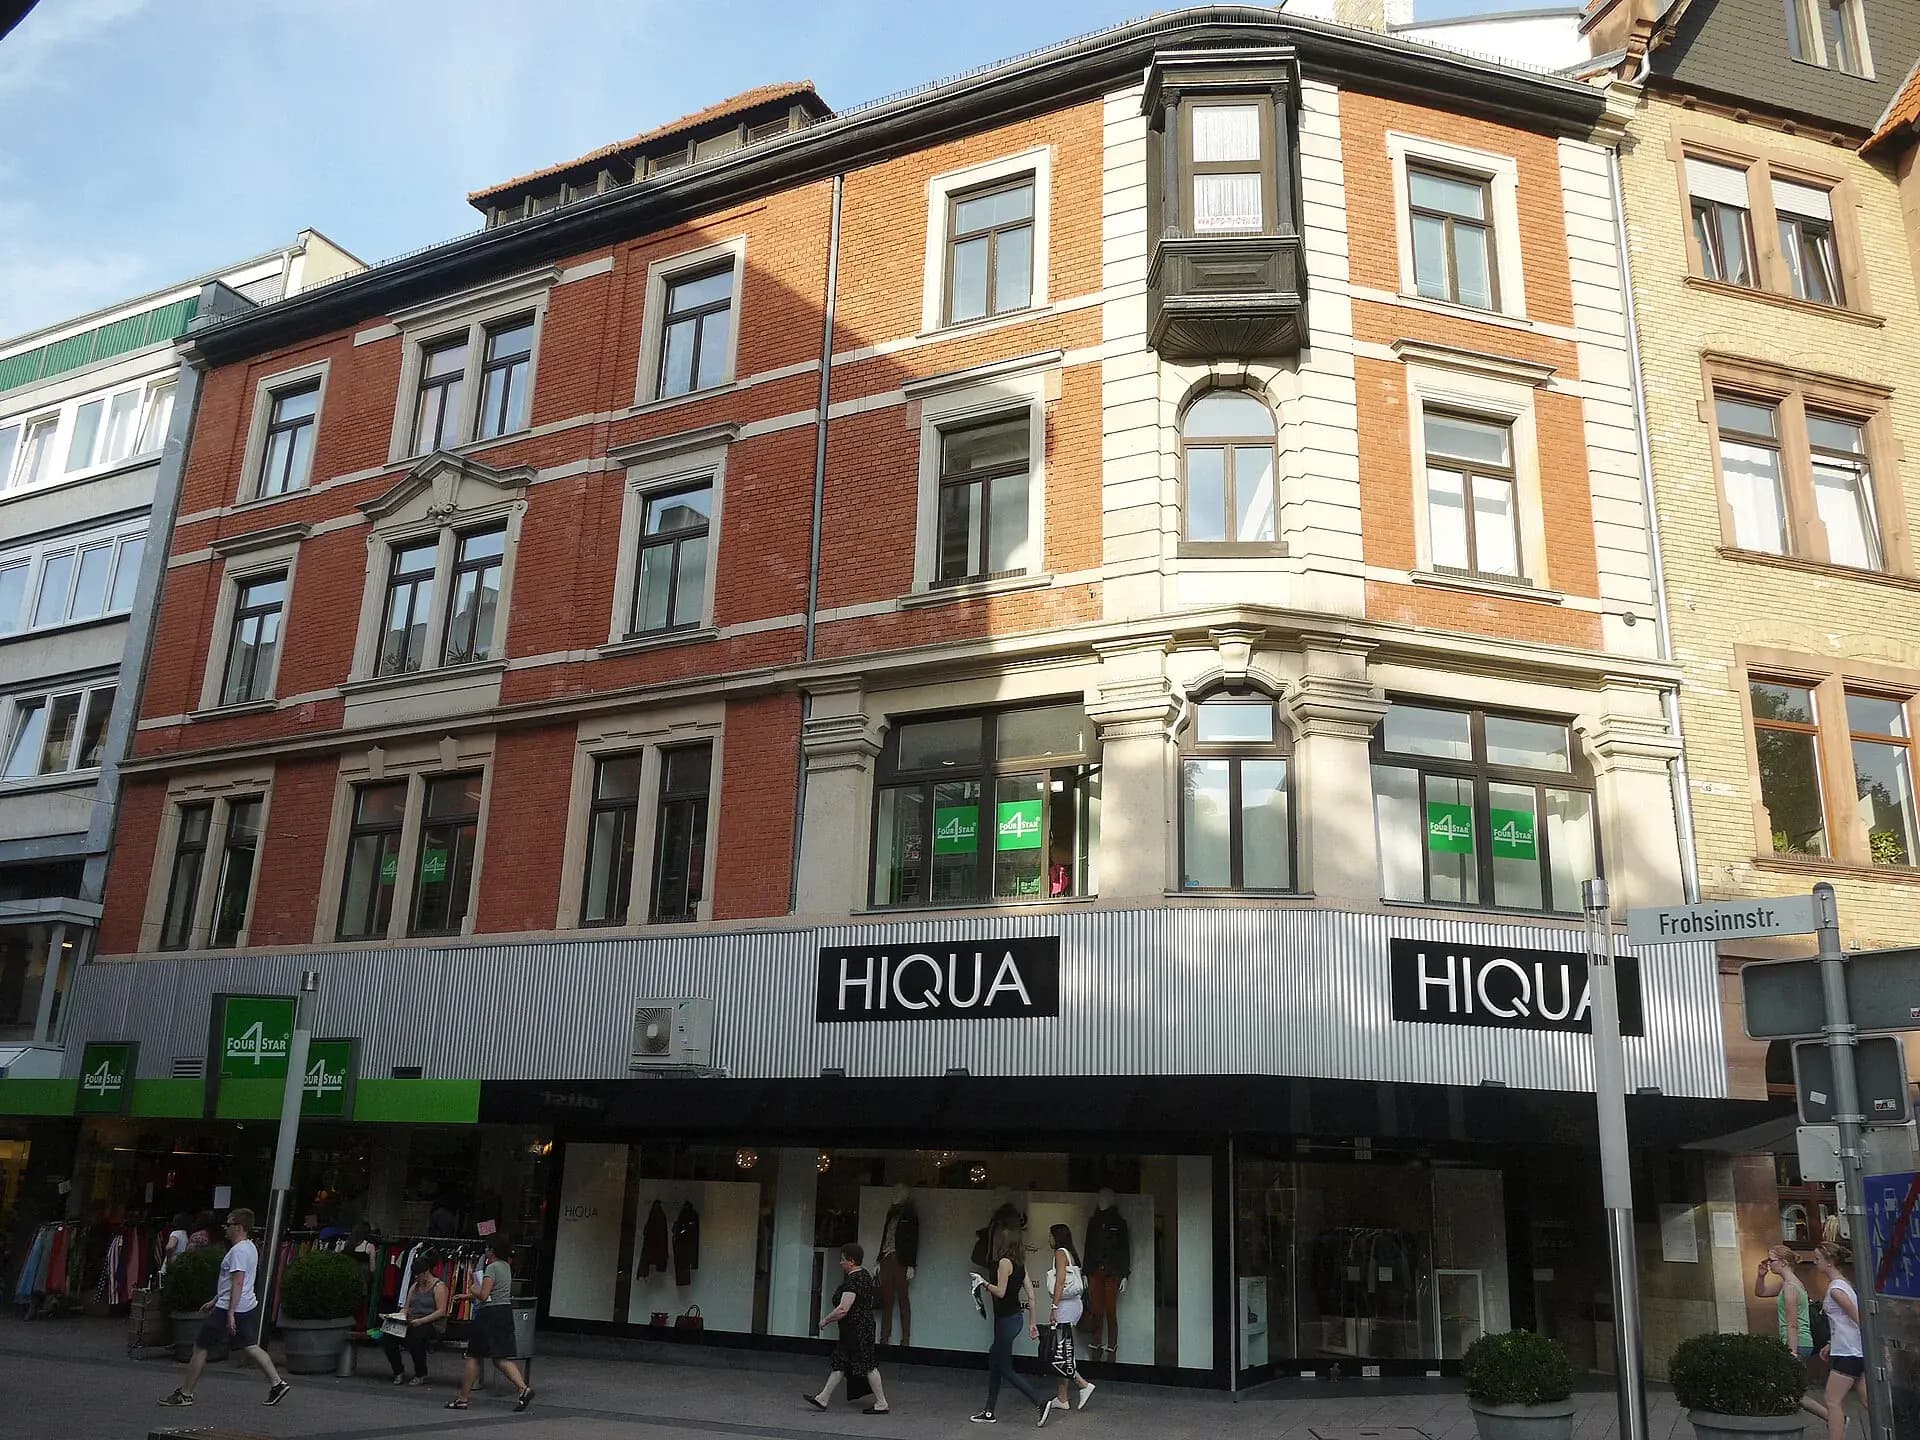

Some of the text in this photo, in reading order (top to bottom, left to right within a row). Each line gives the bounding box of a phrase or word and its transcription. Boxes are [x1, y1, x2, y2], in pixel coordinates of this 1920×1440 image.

[1659, 907, 1780, 936] Frohsinnstr.
[838, 951, 1033, 1011] HIQUA
[227, 1037, 255, 1050] FOUR
[261, 1037, 287, 1050] STAR
[84, 1073, 103, 1084] FOUR
[106, 1073, 122, 1084] STAR
[303, 1075, 319, 1085] OUR
